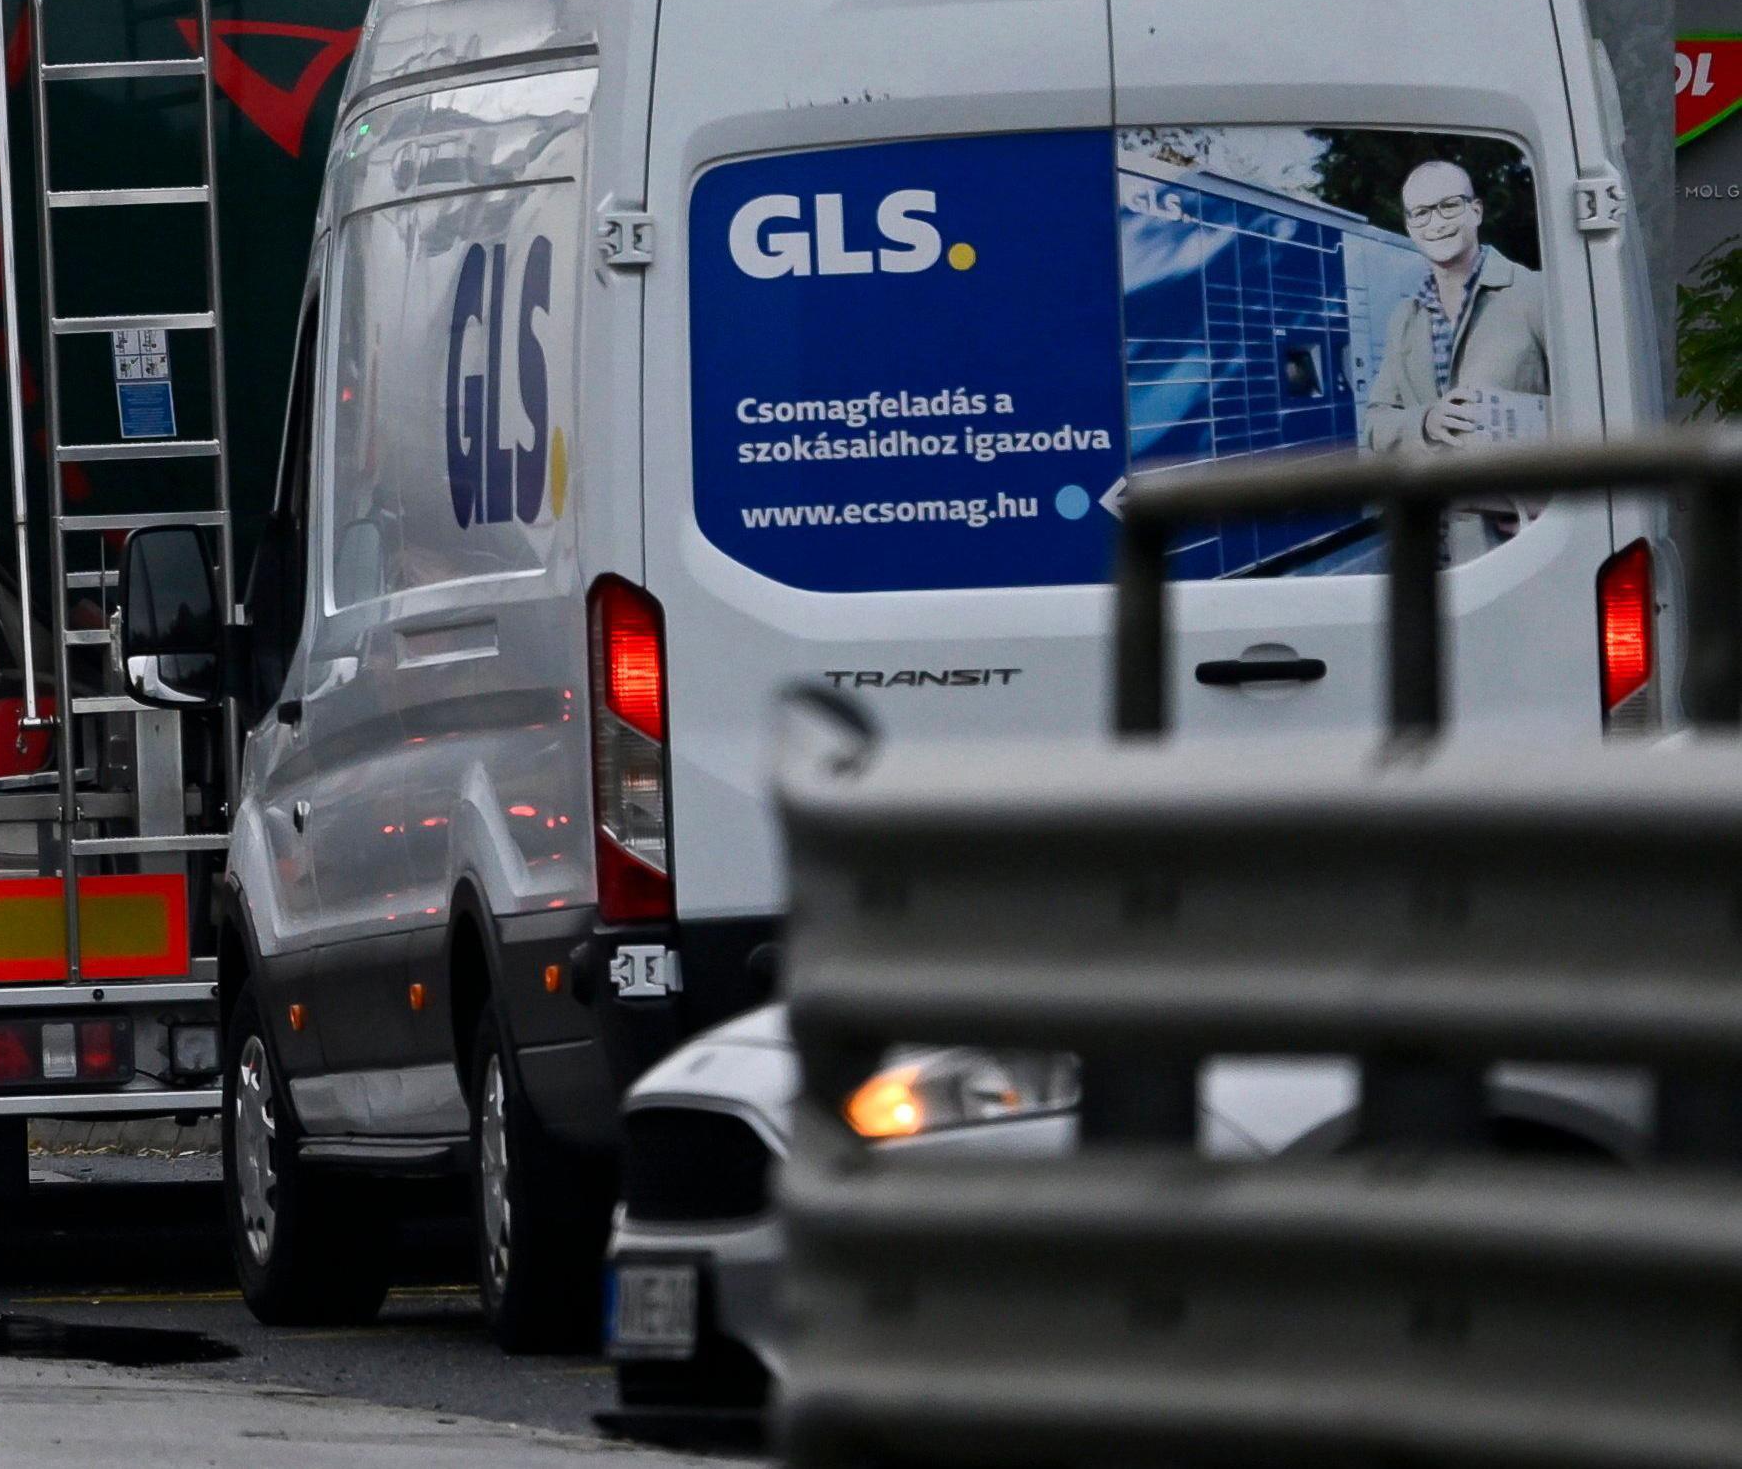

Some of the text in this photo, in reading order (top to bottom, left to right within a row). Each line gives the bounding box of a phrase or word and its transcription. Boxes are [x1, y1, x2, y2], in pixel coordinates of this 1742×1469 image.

[737, 387, 1014, 428] Csomagfeladás a
[738, 424, 1112, 464] szokásaidhoz igazodva
[741, 492, 1038, 529] www.ecsomag.hu
[825, 668, 1022, 688] TRANSIT
